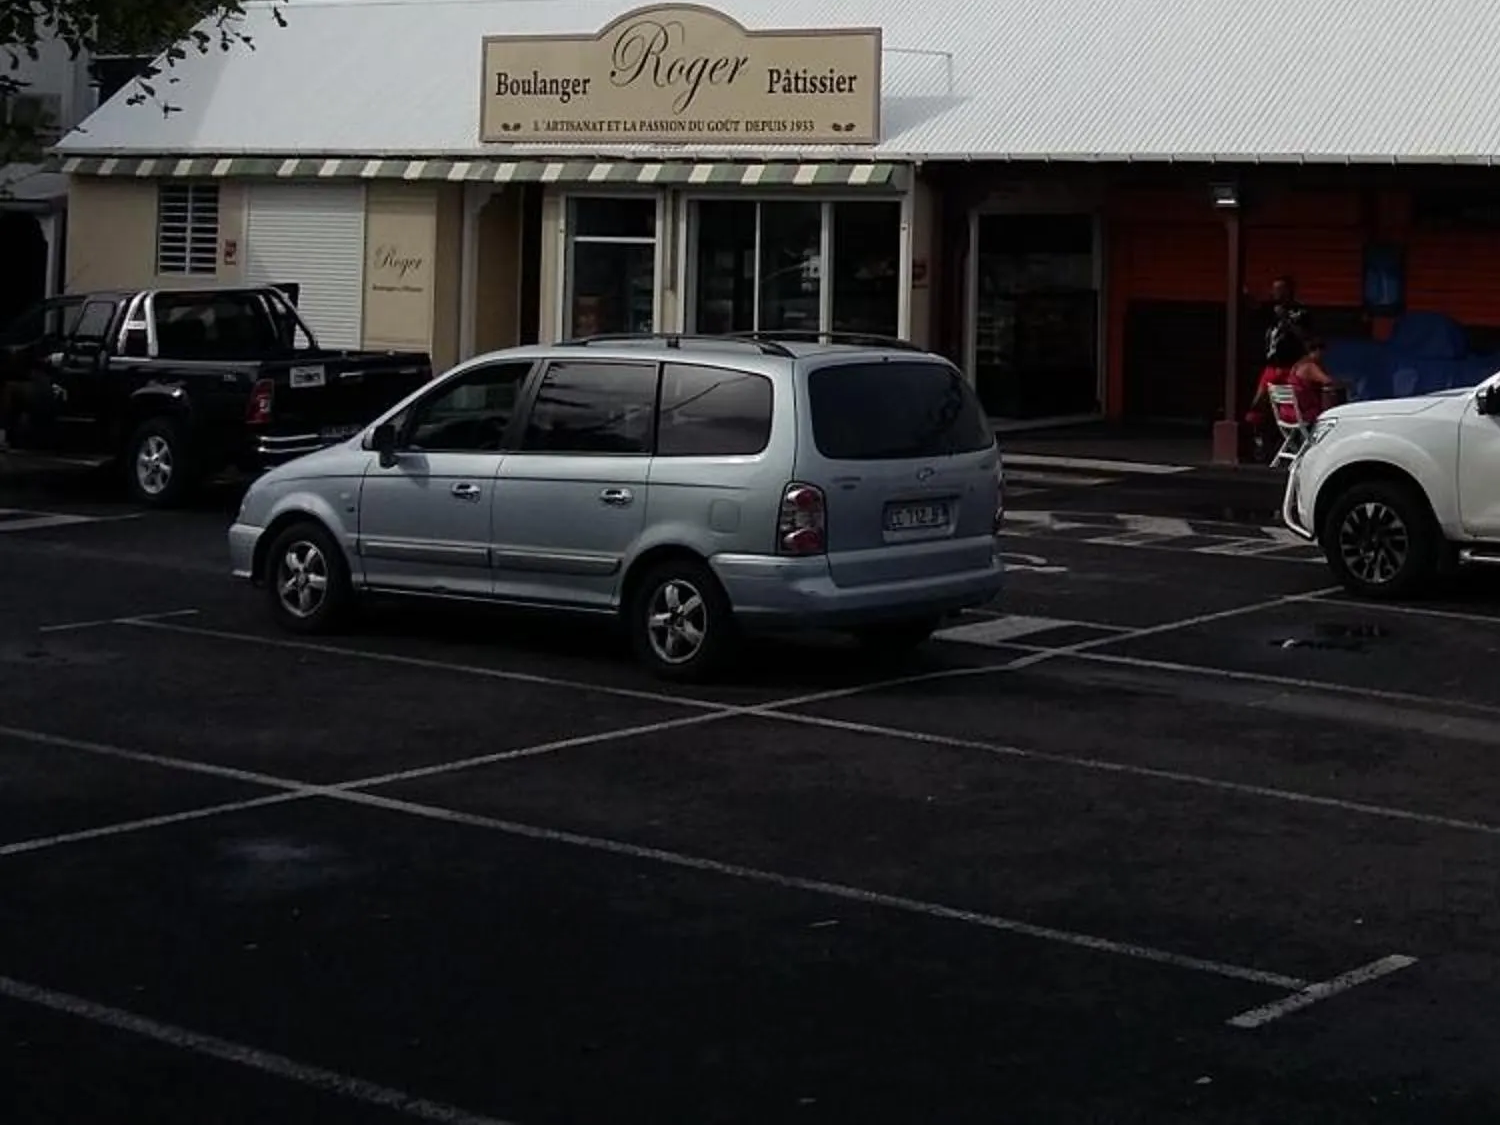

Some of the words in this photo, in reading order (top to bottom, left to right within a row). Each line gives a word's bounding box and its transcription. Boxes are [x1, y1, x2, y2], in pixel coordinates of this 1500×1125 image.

[609, 20, 749, 115] Roger
[495, 70, 591, 103] Boulanger
[767, 68, 858, 94] Pâtissier
[606, 120, 621, 132] ET
[623, 120, 637, 132] LA
[639, 119, 685, 132] PASSION
[688, 119, 704, 132] DU
[707, 116, 740, 132] GOÛT
[745, 119, 787, 132] DEPUIS
[371, 241, 423, 276] Roger
